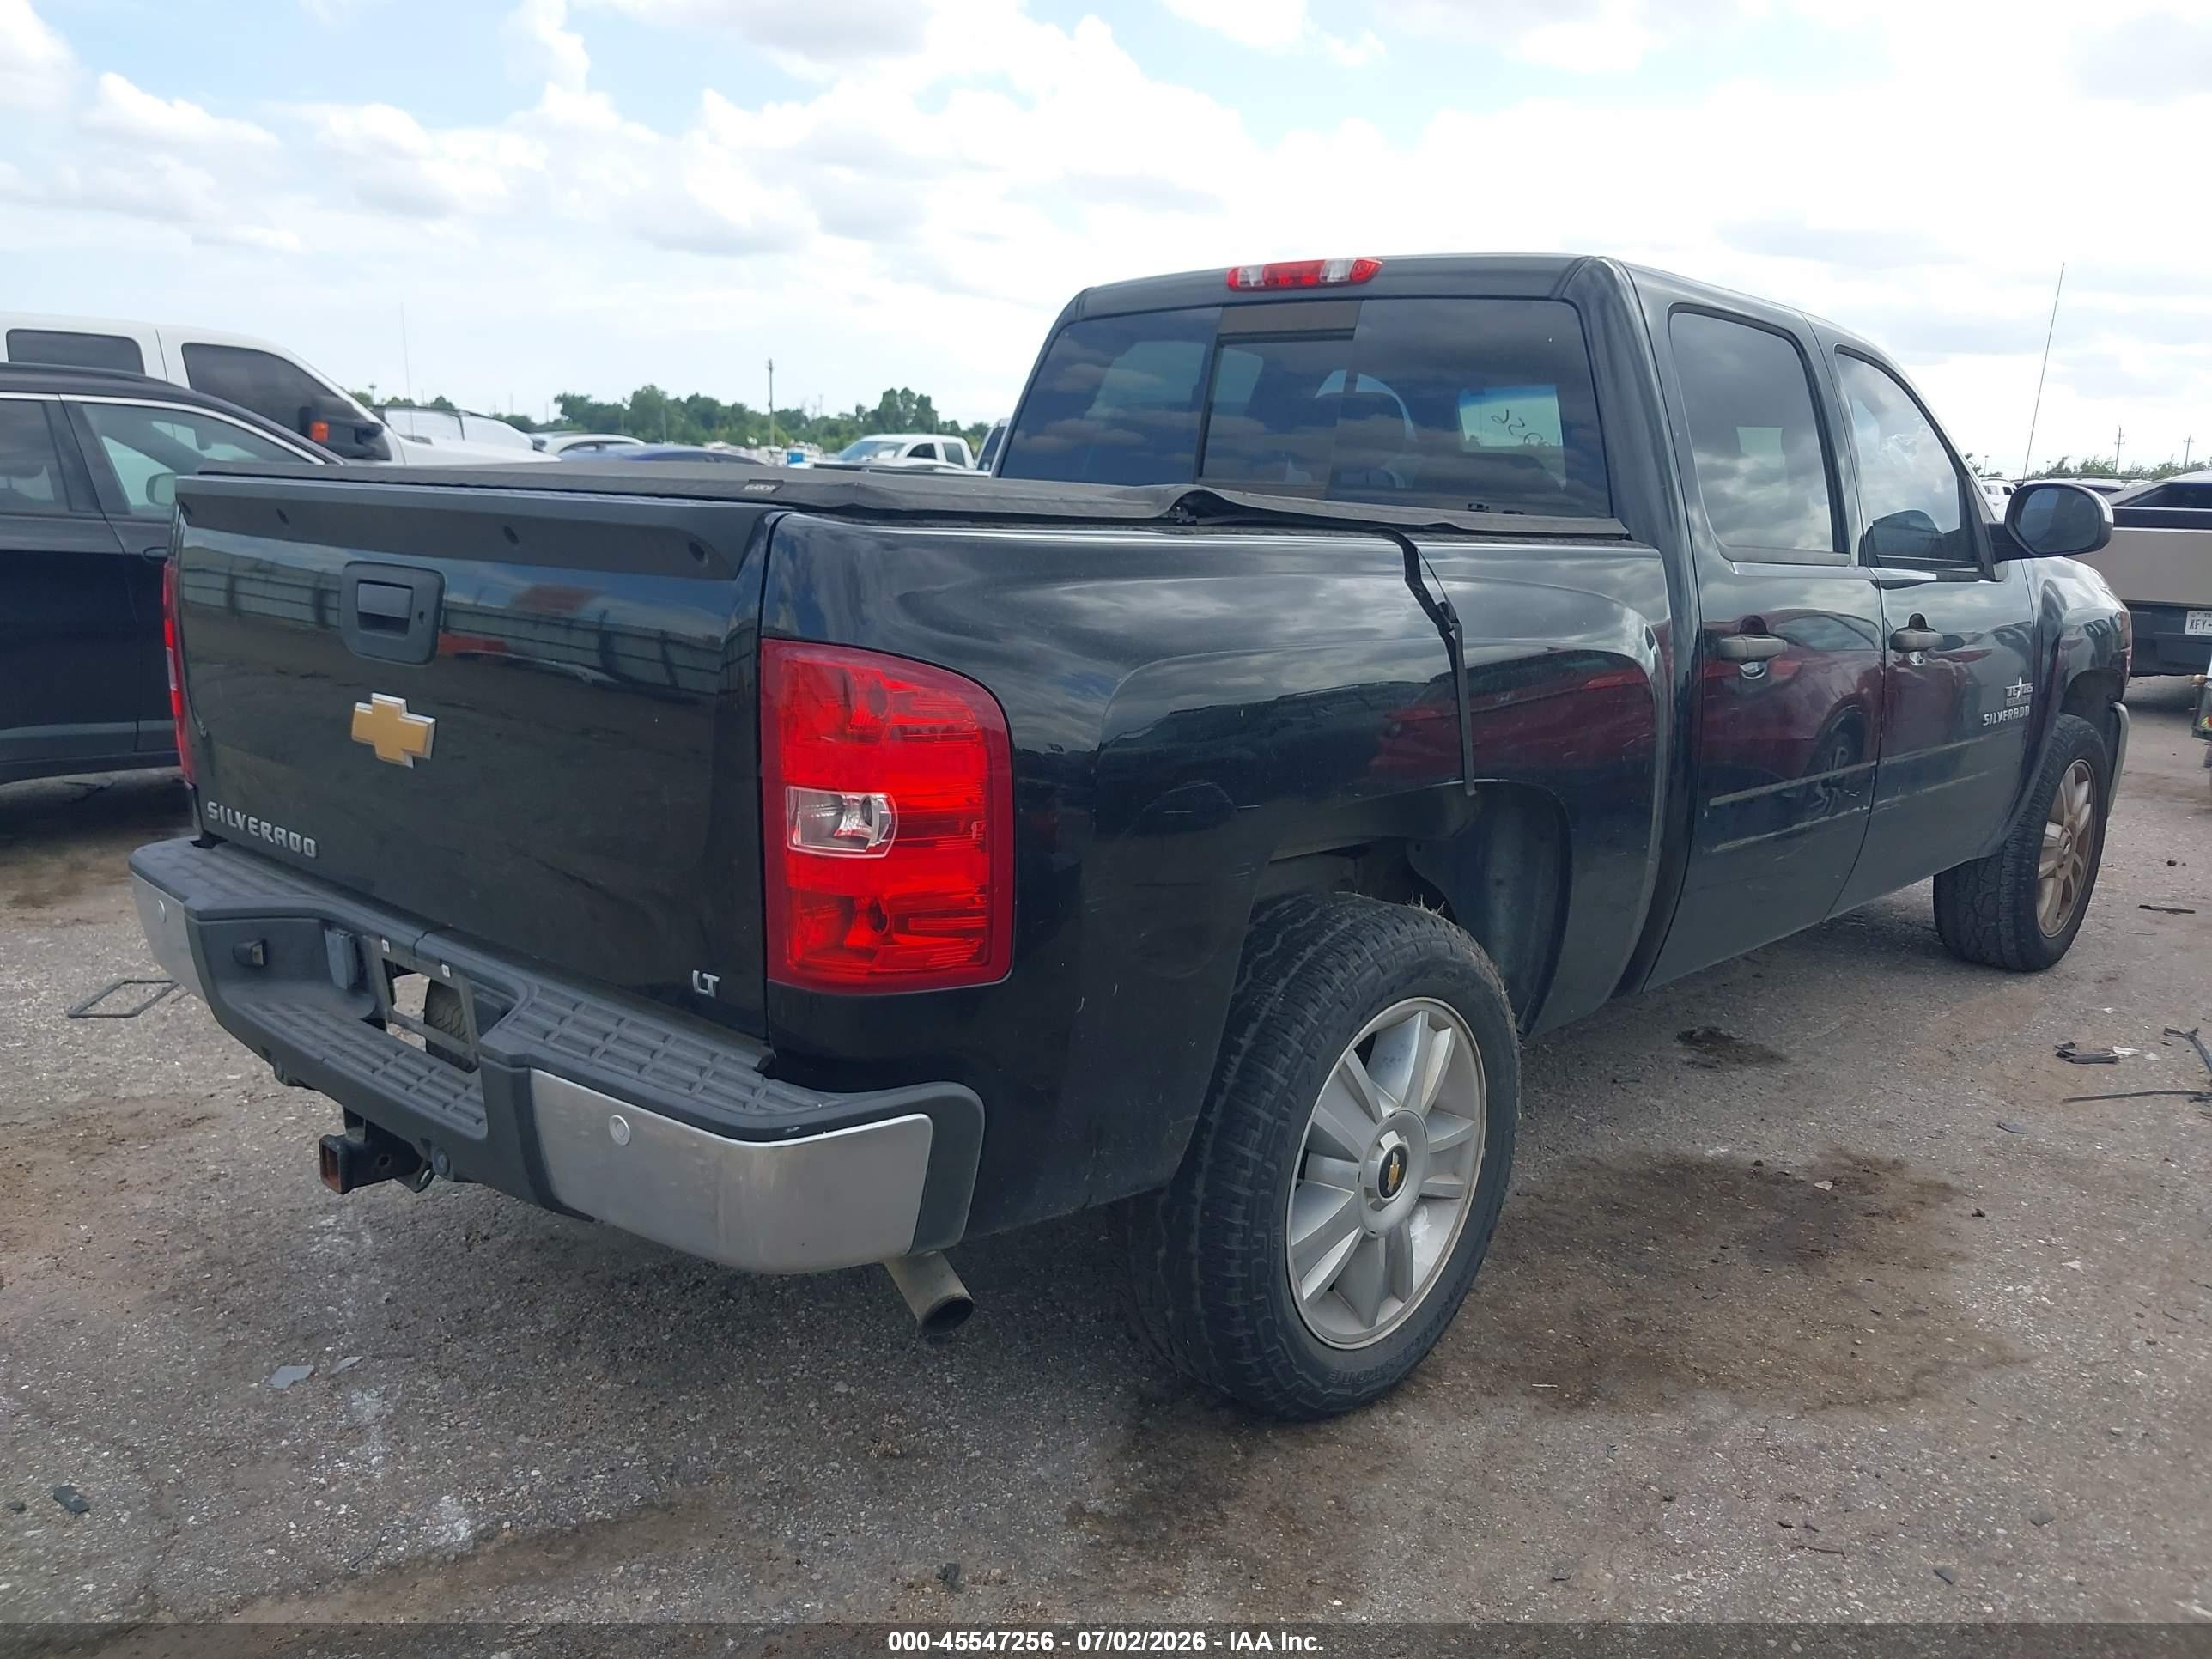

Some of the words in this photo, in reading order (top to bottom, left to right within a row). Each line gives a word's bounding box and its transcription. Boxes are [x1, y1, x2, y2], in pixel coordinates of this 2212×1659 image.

[1982, 705, 2030, 726] SILVERADO
[207, 800, 317, 859] SILVERADO
[692, 969, 720, 997] LT
